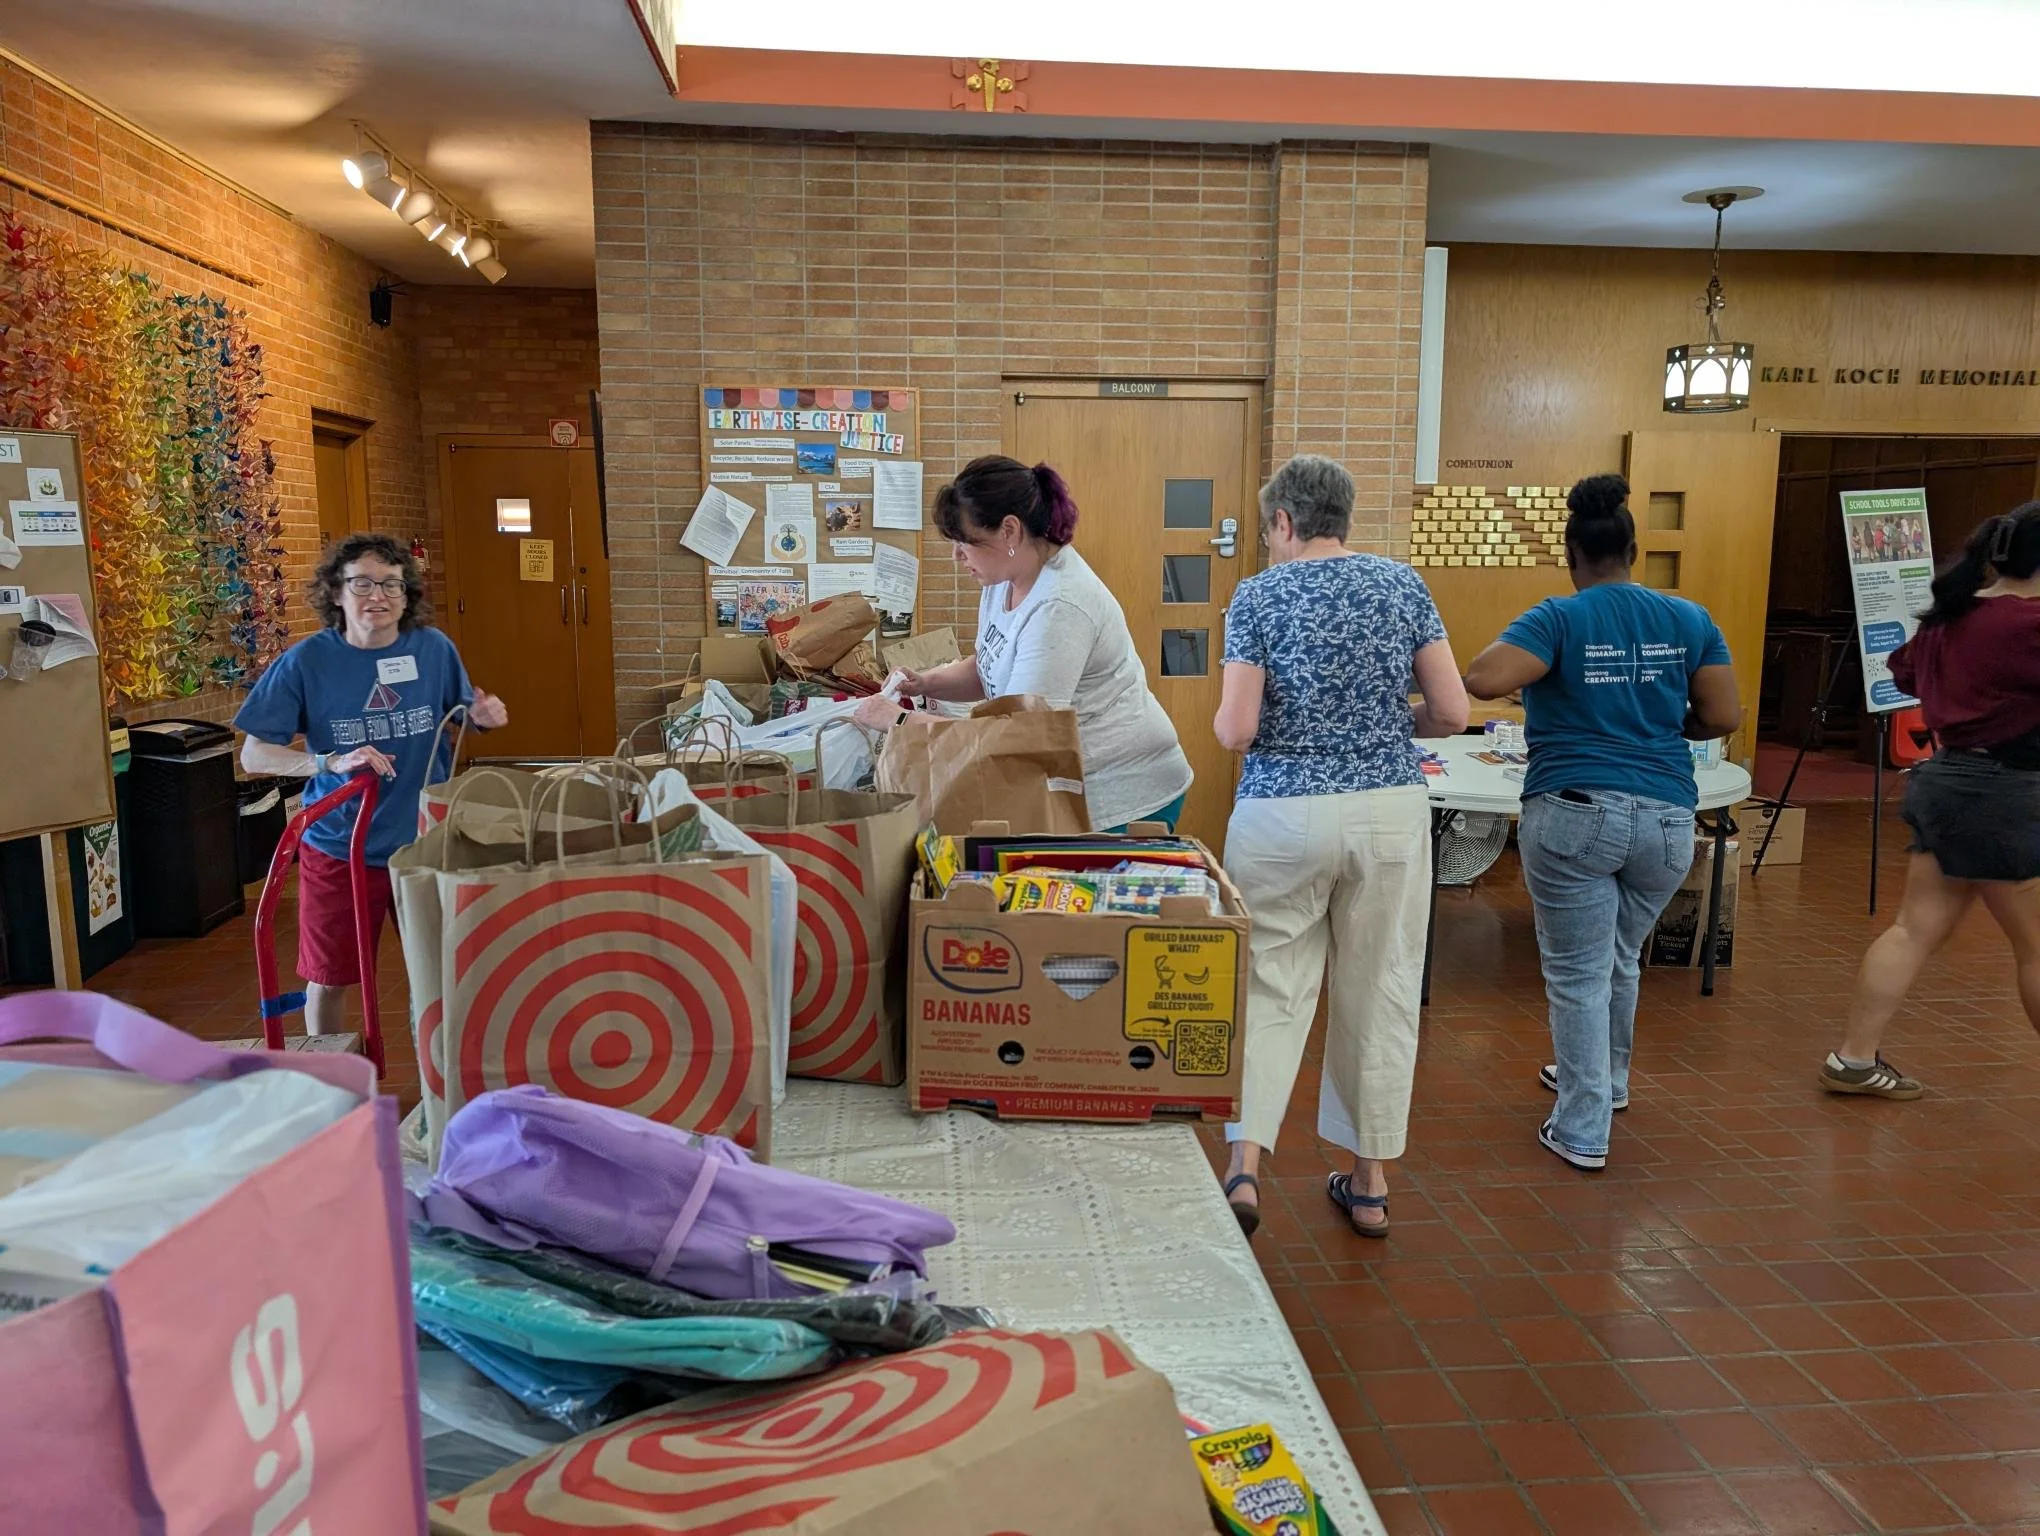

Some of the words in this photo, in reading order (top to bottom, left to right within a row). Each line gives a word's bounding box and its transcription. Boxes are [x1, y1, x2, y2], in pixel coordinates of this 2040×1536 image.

[1760, 366, 1820, 383] KARL
[1833, 367, 1901, 385] KOCH
[1919, 368, 2040, 386] MEMORIAL
[1111, 383, 1156, 393] BALCONY
[842, 431, 902, 453] JUSTICE
[1446, 459, 1514, 469] COMMUNION
[1849, 499, 1872, 510] SCHOOL
[1872, 498, 1890, 509] TOOLS
[1890, 498, 1906, 508] DRIVE
[1585, 650, 1626, 658] HUMANITY
[1641, 648, 1687, 656] COMMUNITY
[1584, 676, 1629, 684] CREATIVITY
[1640, 675, 1655, 683] JOY
[1144, 932, 1177, 942] GRILLED
[1179, 933, 1225, 943] BANANAS?
[1660, 940, 1686, 948] Tickets
[942, 939, 1010, 968] Dole
[1154, 992, 1170, 1001] DES
[923, 999, 1032, 1026] BANANAS
[973, 1079, 993, 1087] DOLE
[995, 1080, 1019, 1088] FRESH
[1016, 1097, 1073, 1111] PREMIUM
[1077, 1100, 1135, 1113] BANANAS
[1202, 1431, 1266, 1455] Crayola
[1235, 1483, 1304, 1514] WASHABLE
[1251, 1498, 1307, 1525] CRAYONS
